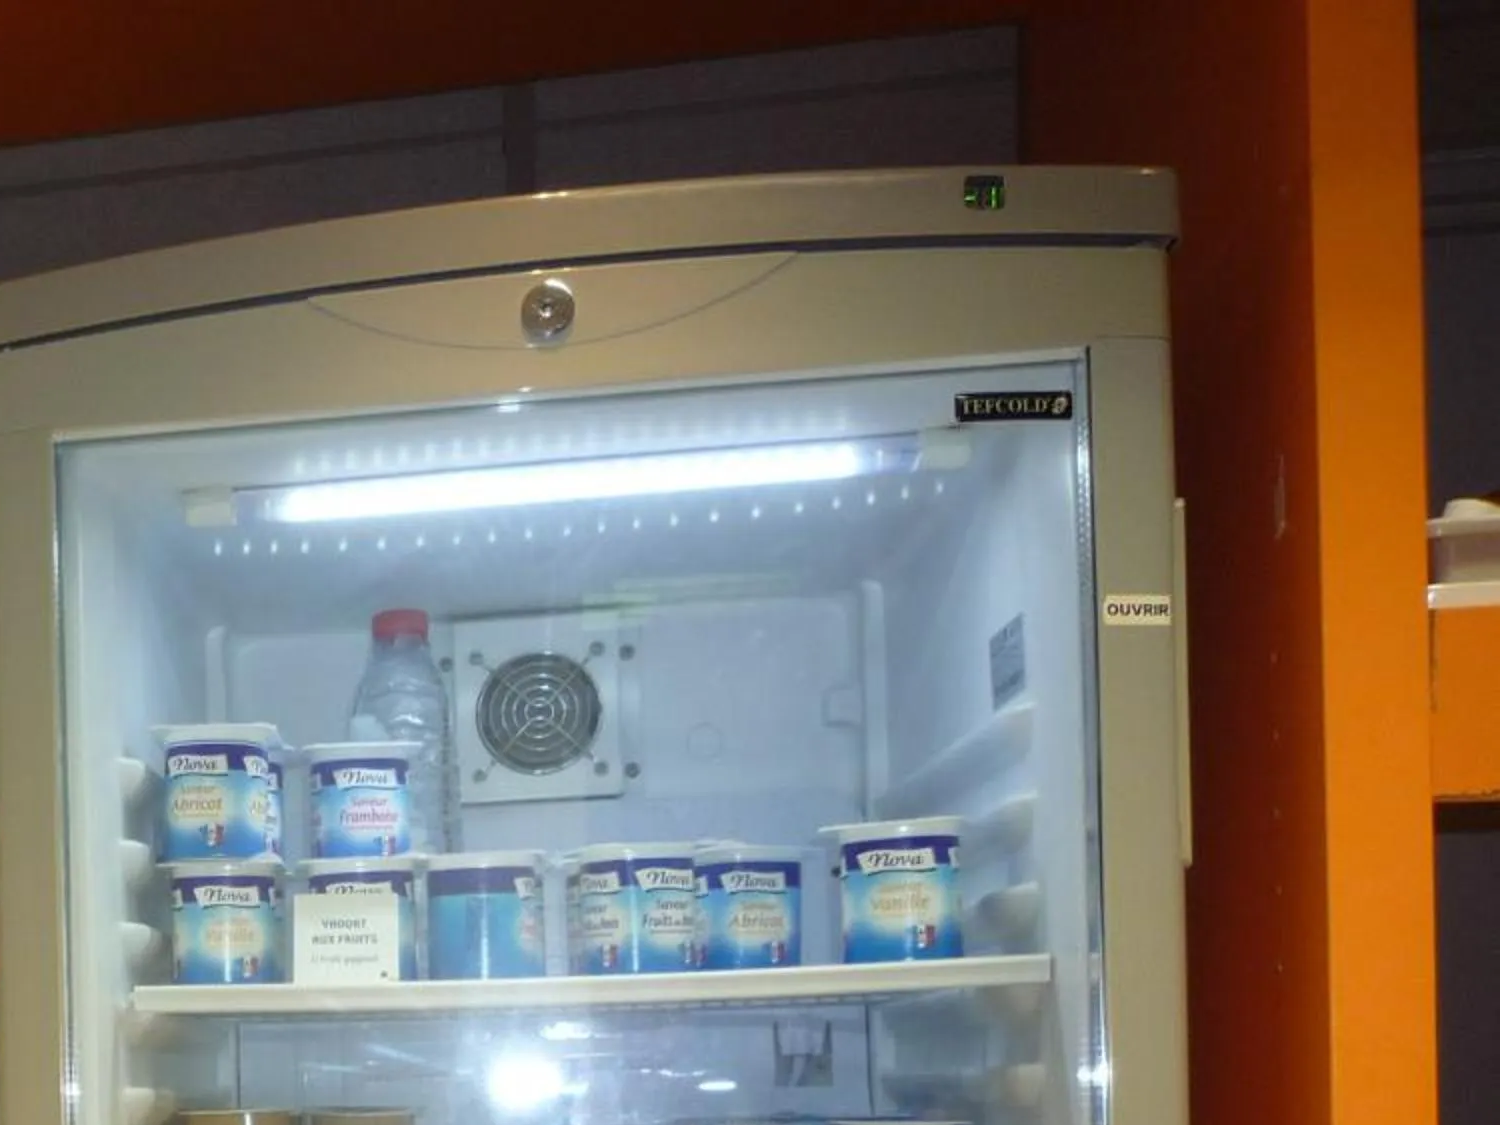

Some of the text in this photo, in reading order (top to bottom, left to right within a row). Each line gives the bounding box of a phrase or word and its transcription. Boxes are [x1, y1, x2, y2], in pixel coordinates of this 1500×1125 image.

[961, 397, 1046, 415] TEFCOLD
[1107, 603, 1169, 616] OUVRIR
[174, 756, 218, 770] Nova
[342, 771, 389, 784] Nova
[870, 853, 925, 867] Nova
[731, 875, 777, 888] Nova
[203, 888, 250, 902] Nova
